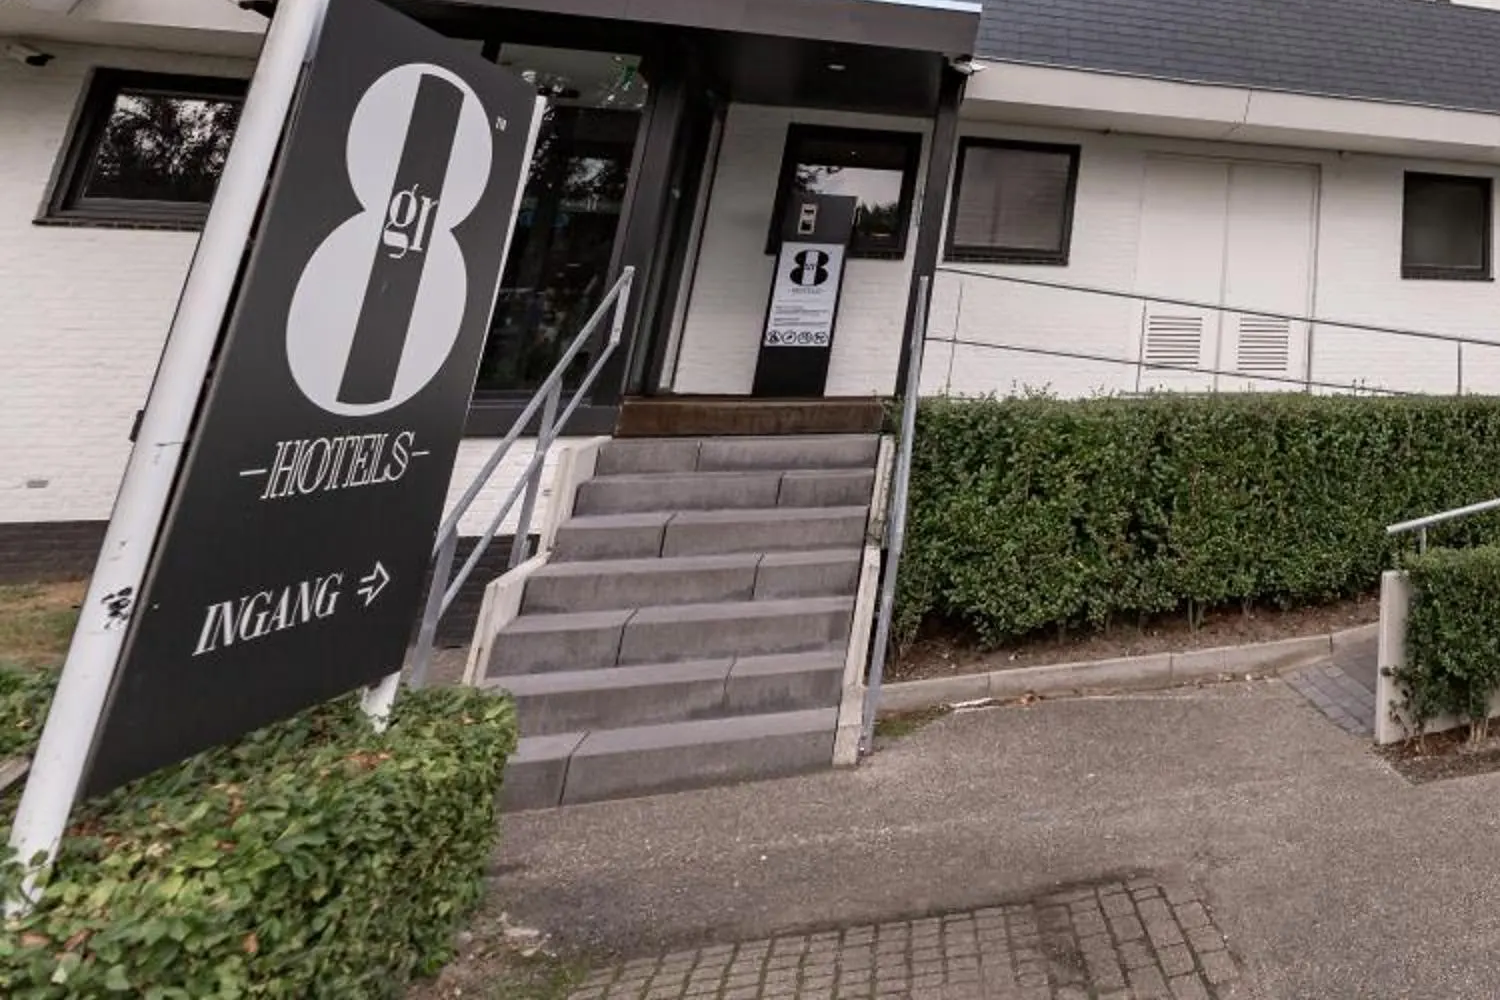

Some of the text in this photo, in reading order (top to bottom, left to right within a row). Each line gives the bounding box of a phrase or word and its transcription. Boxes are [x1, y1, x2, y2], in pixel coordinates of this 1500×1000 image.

[286, 62, 493, 416] 8
[382, 183, 440, 259] gr
[260, 431, 416, 500] HOTELS
[192, 572, 345, 656] INGANG
